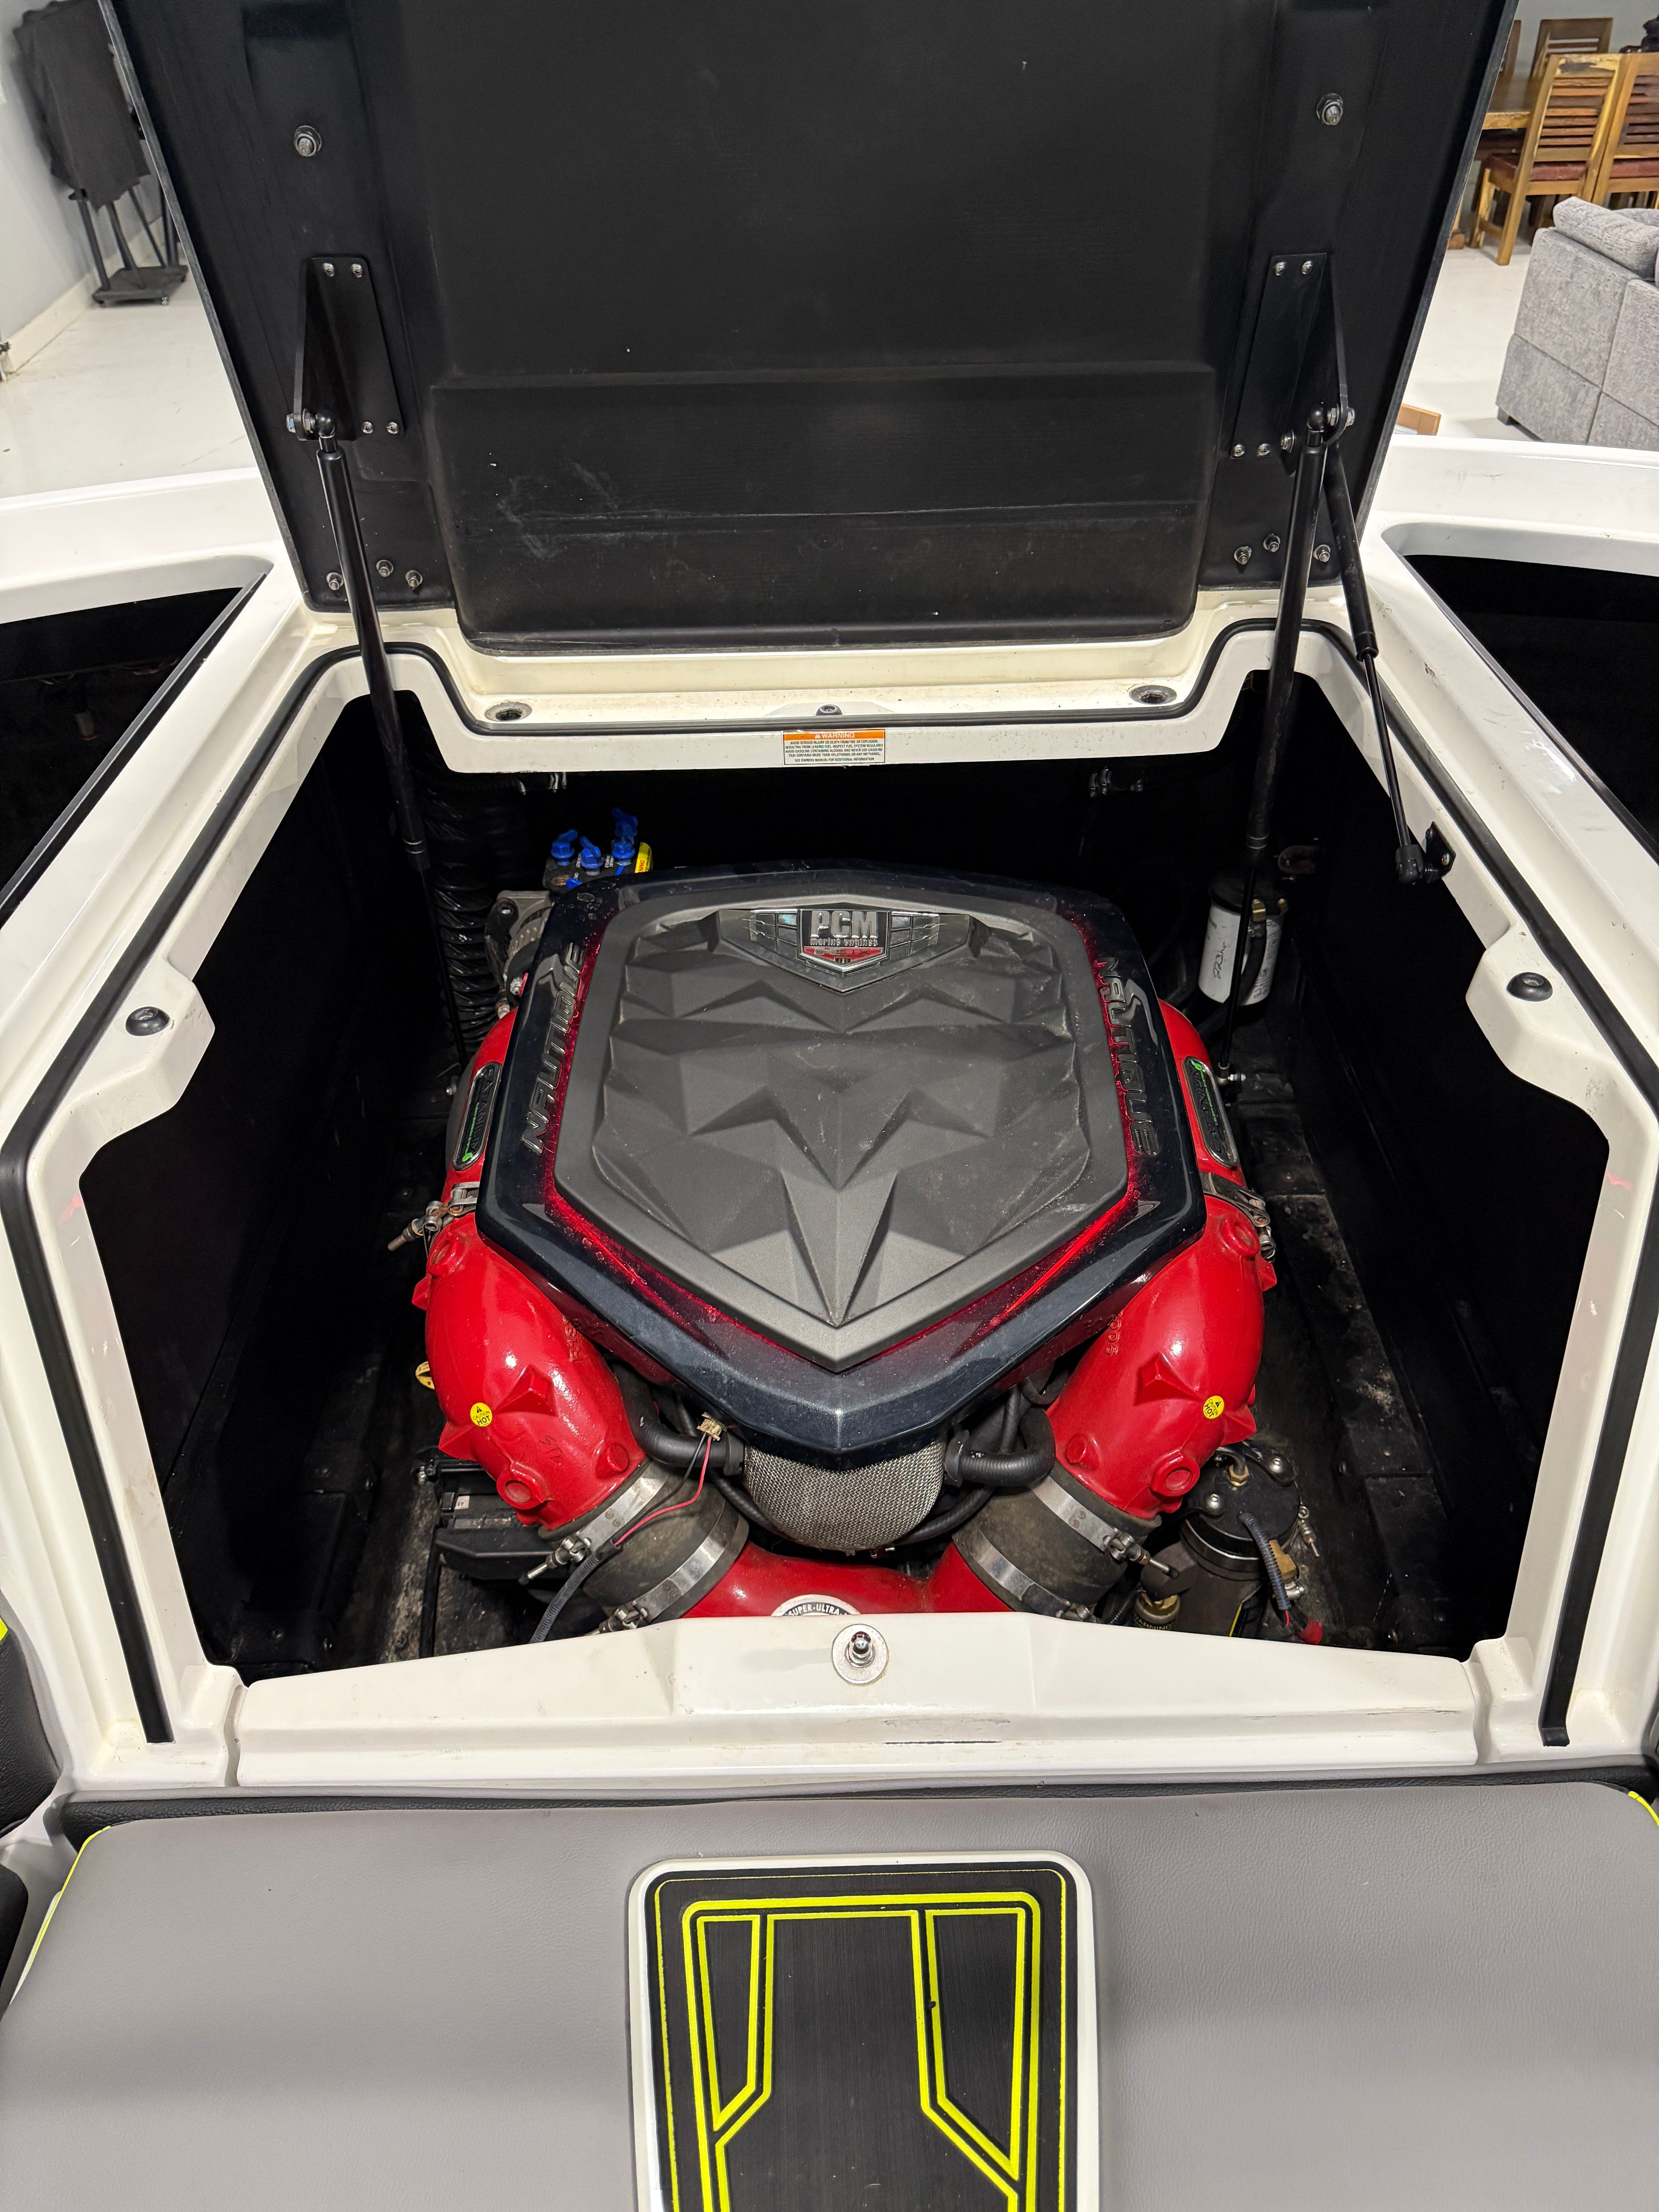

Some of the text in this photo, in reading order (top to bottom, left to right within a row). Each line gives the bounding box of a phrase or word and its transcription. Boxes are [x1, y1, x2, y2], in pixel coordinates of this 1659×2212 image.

[810, 910, 878, 939] PCM
[810, 938, 878, 948] marine engines
[522, 942, 585, 1154] NAUTIQUE
[1096, 957, 1159, 1156] NAUTIQUE
[473, 1410, 490, 1420] CAUTION
[1204, 1403, 1214, 1417] HOT
[1209, 1399, 1218, 1416] CAUTION
[477, 1415, 490, 1425] HOT
